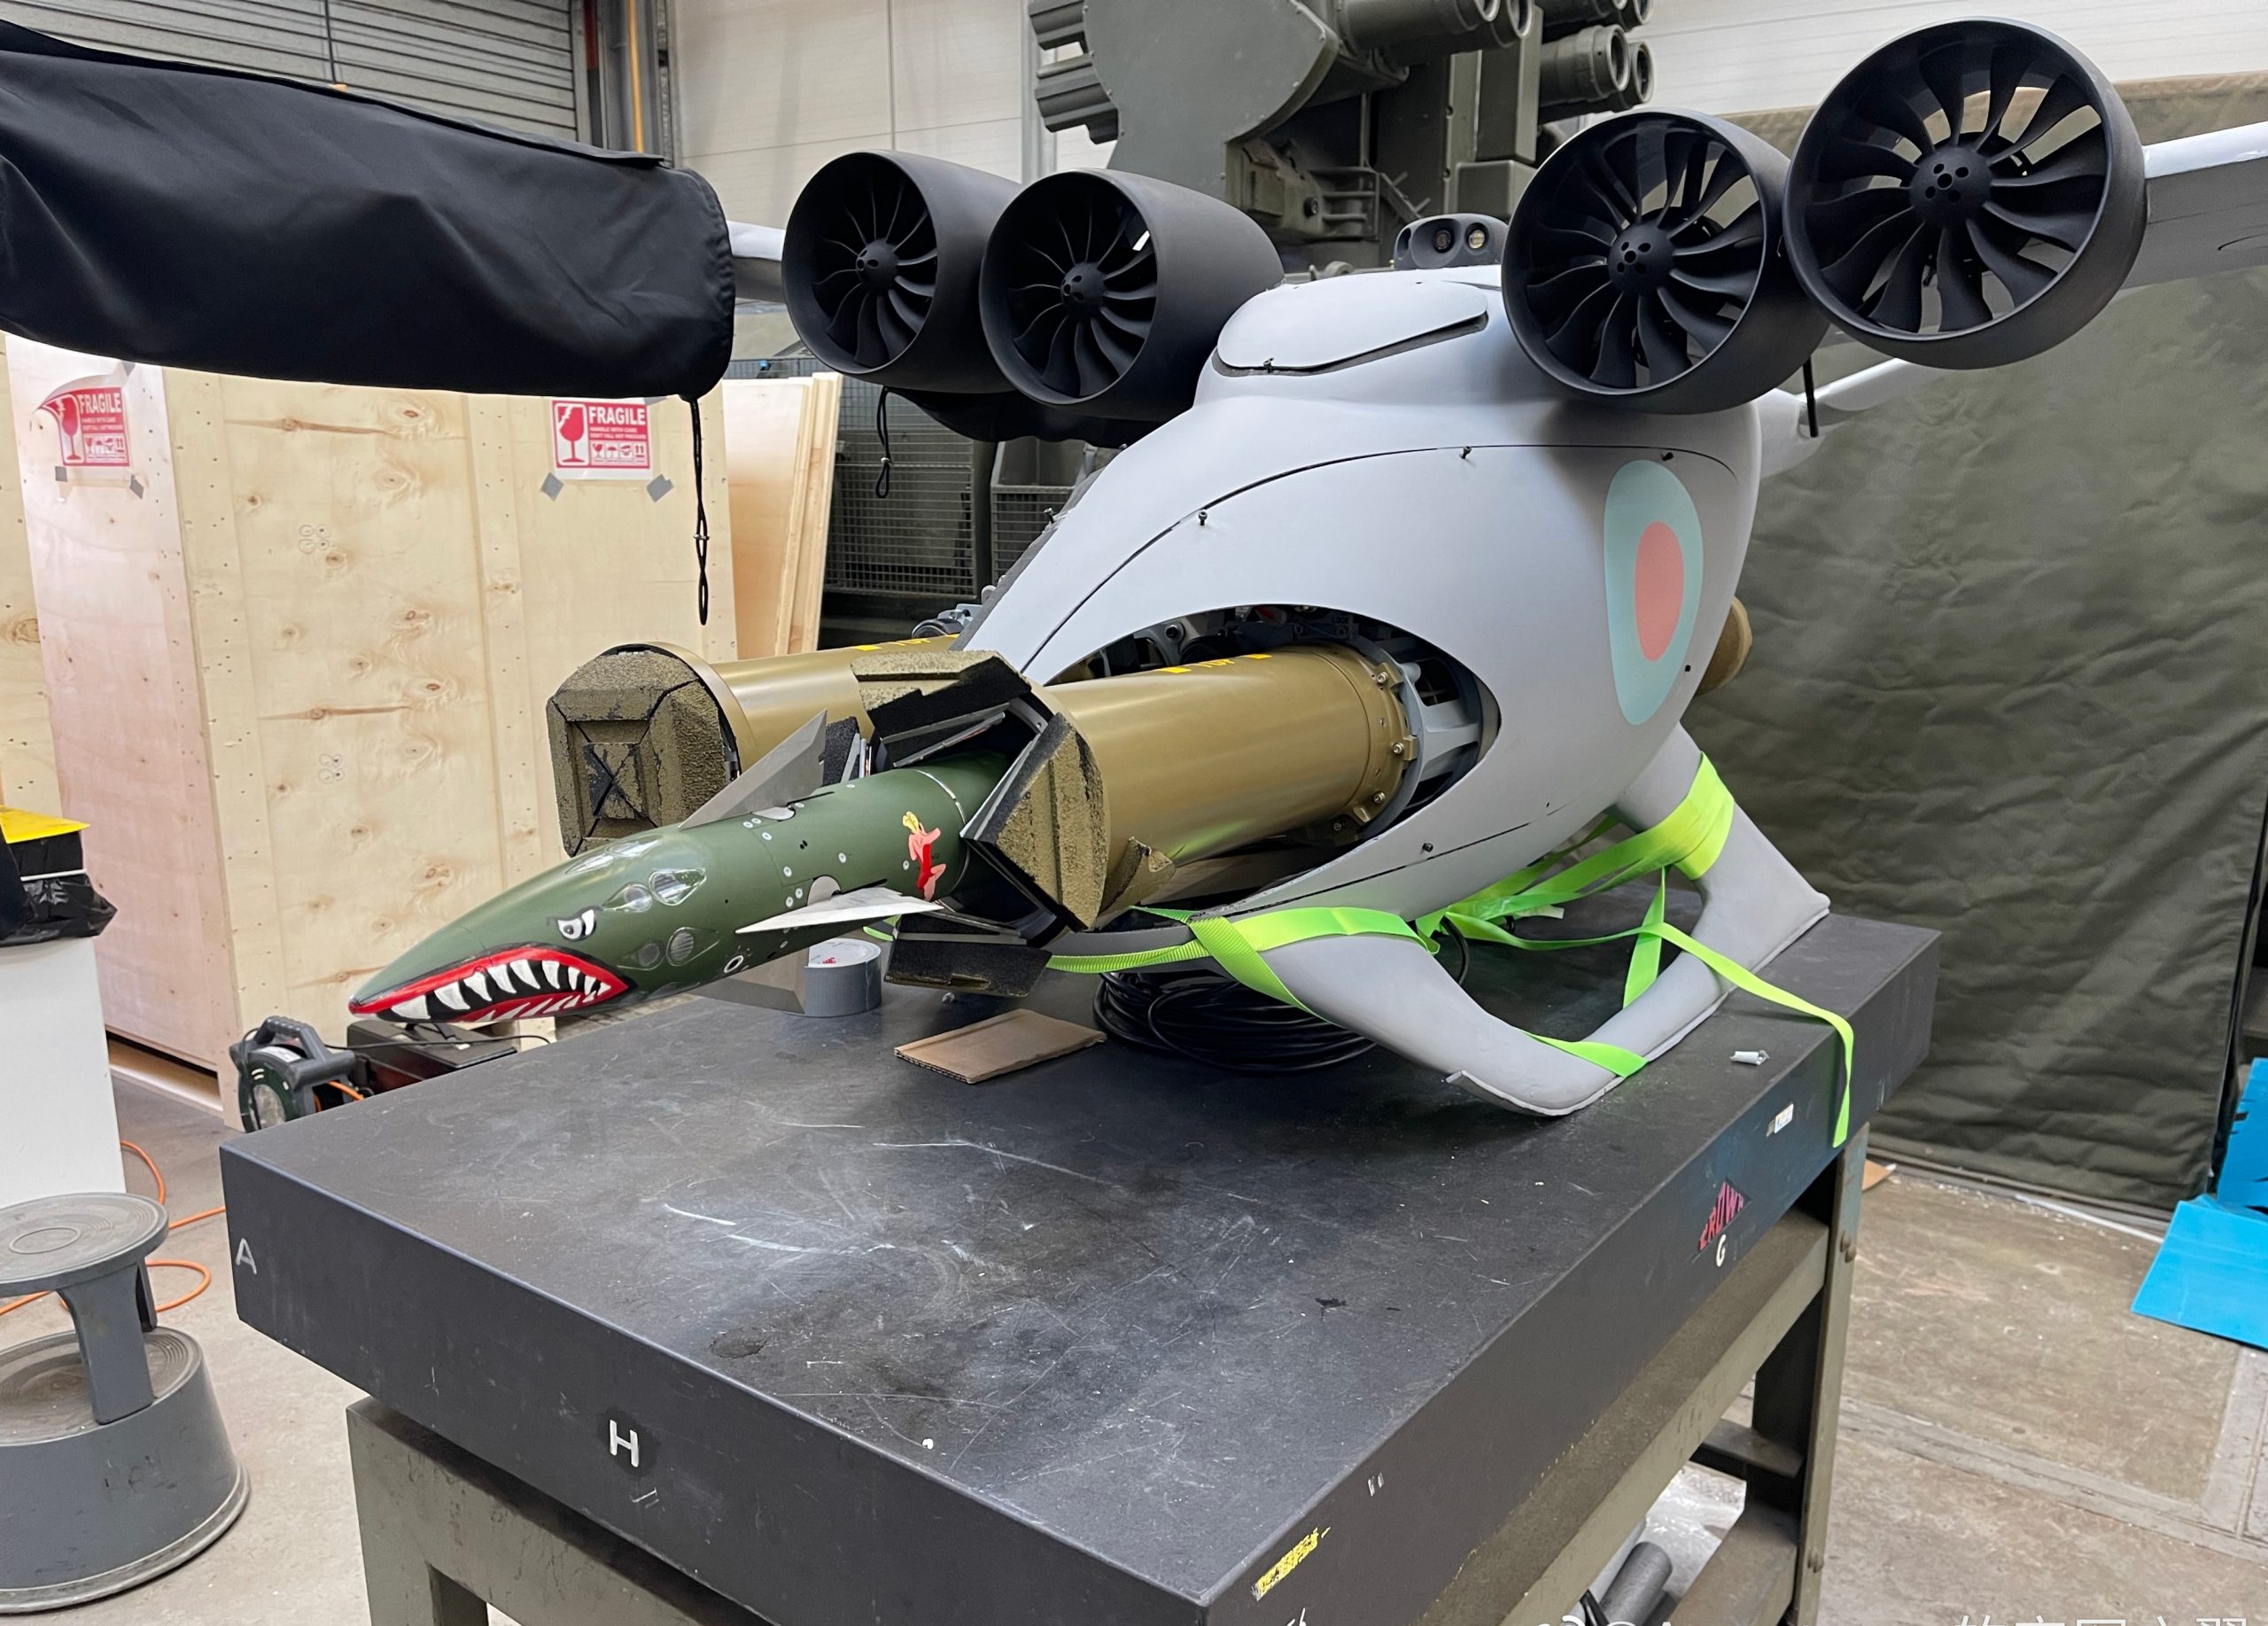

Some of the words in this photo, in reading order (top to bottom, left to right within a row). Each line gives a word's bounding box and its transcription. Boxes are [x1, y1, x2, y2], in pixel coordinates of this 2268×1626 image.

[77, 393, 122, 414] FRAGILE
[588, 406, 646, 425] FRAGILE
[235, 1237, 258, 1275] A
[609, 1419, 639, 1467] H
